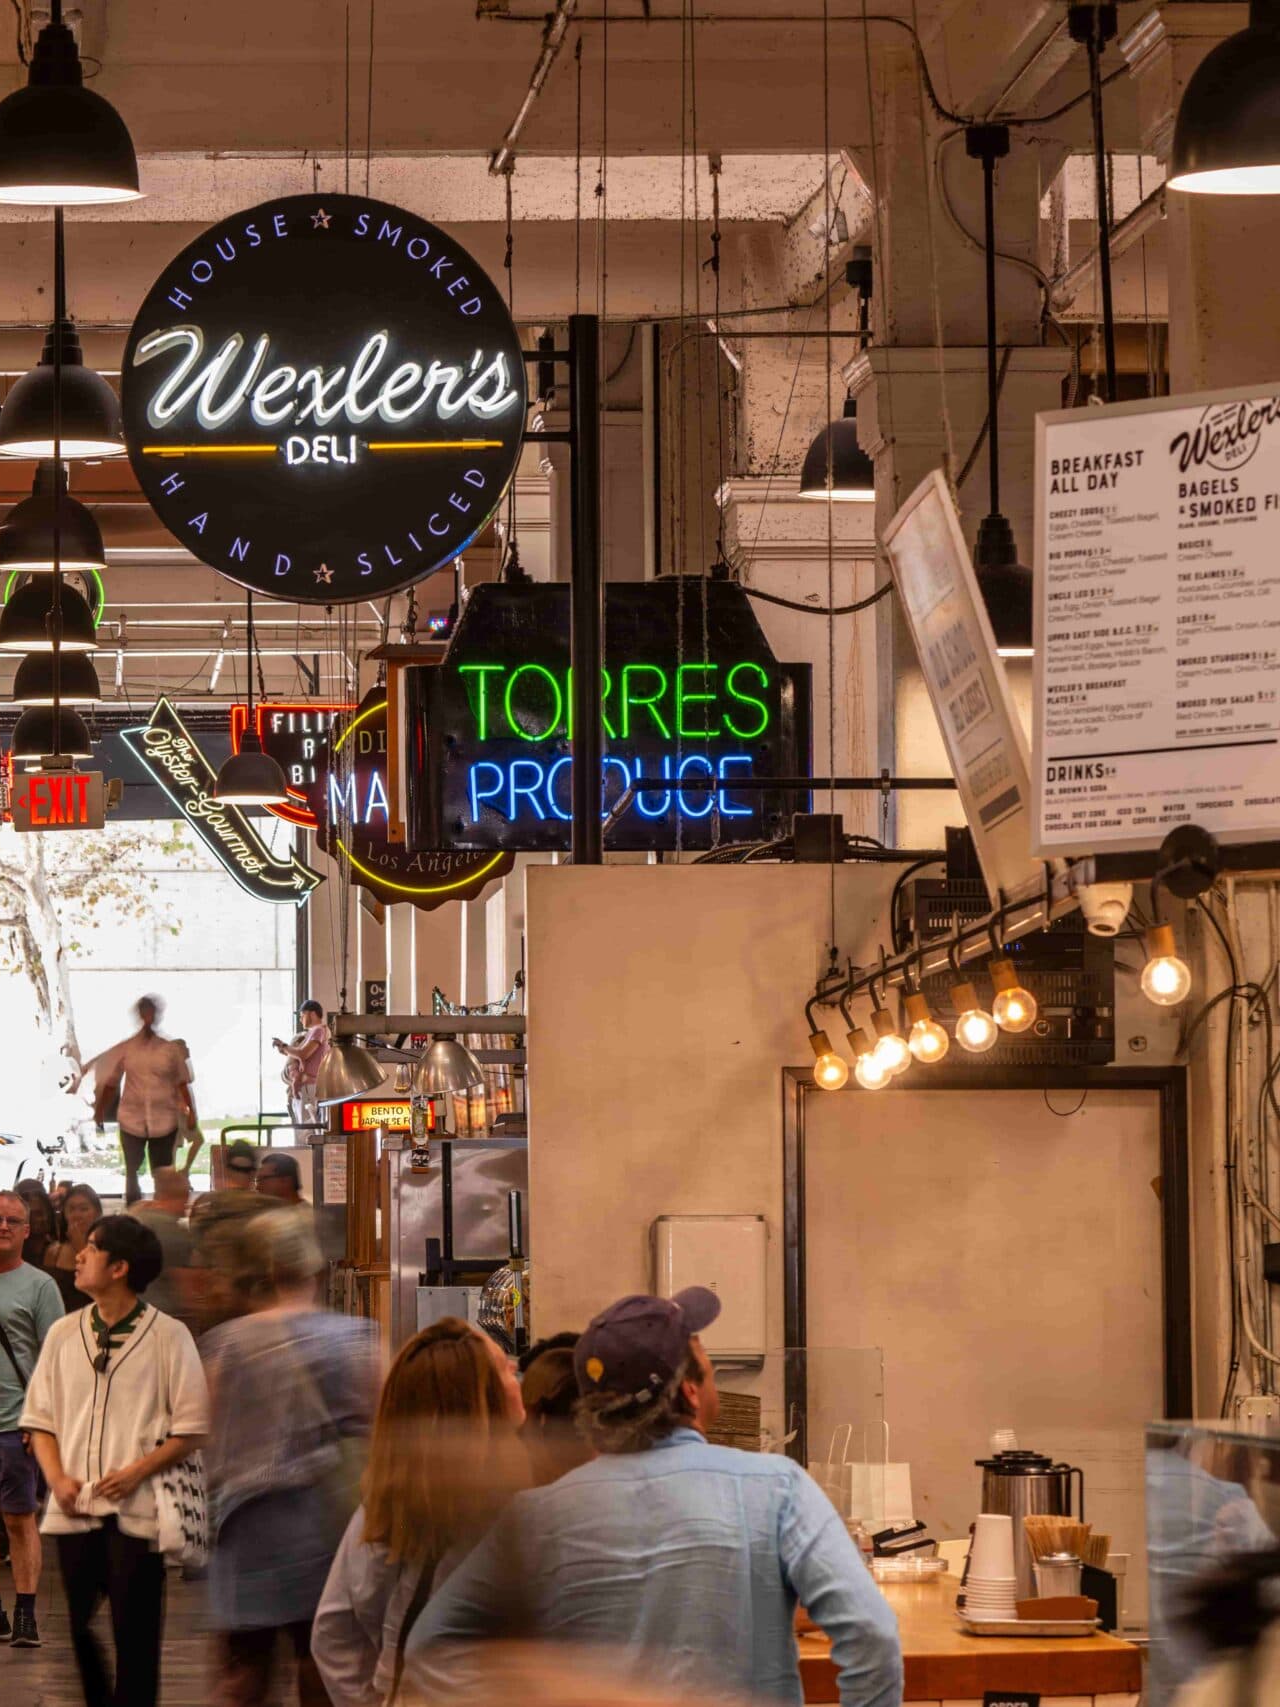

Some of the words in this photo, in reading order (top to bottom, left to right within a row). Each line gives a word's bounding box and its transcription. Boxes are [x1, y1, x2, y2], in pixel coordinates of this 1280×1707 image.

[168, 214, 289, 310] HOUSE
[354, 214, 482, 316] SMOKED
[133, 324, 519, 430] Wexler's
[285, 435, 357, 465] DELI
[1051, 450, 1144, 475] BREAKFAST
[1225, 444, 1247, 461] DELI
[1050, 477, 1079, 494] ALL
[1087, 472, 1118, 490] DAY
[1179, 477, 1239, 498] BAGELS
[1189, 496, 1256, 518] SMOKED
[1264, 494, 1280, 511] FI
[161, 472, 292, 578] HAND
[357, 469, 486, 576] SLICED
[458, 662, 770, 742] TORRES
[171, 736, 194, 764] The
[1046, 763, 1104, 783] DRINKS
[29, 776, 90, 825] EXIT
[328, 771, 389, 825] MA
[469, 755, 753, 823] PRODUCE
[185, 791, 268, 874] Gourmet
[367, 841, 399, 869] Los
[371, 1107, 404, 1116] BENTO
